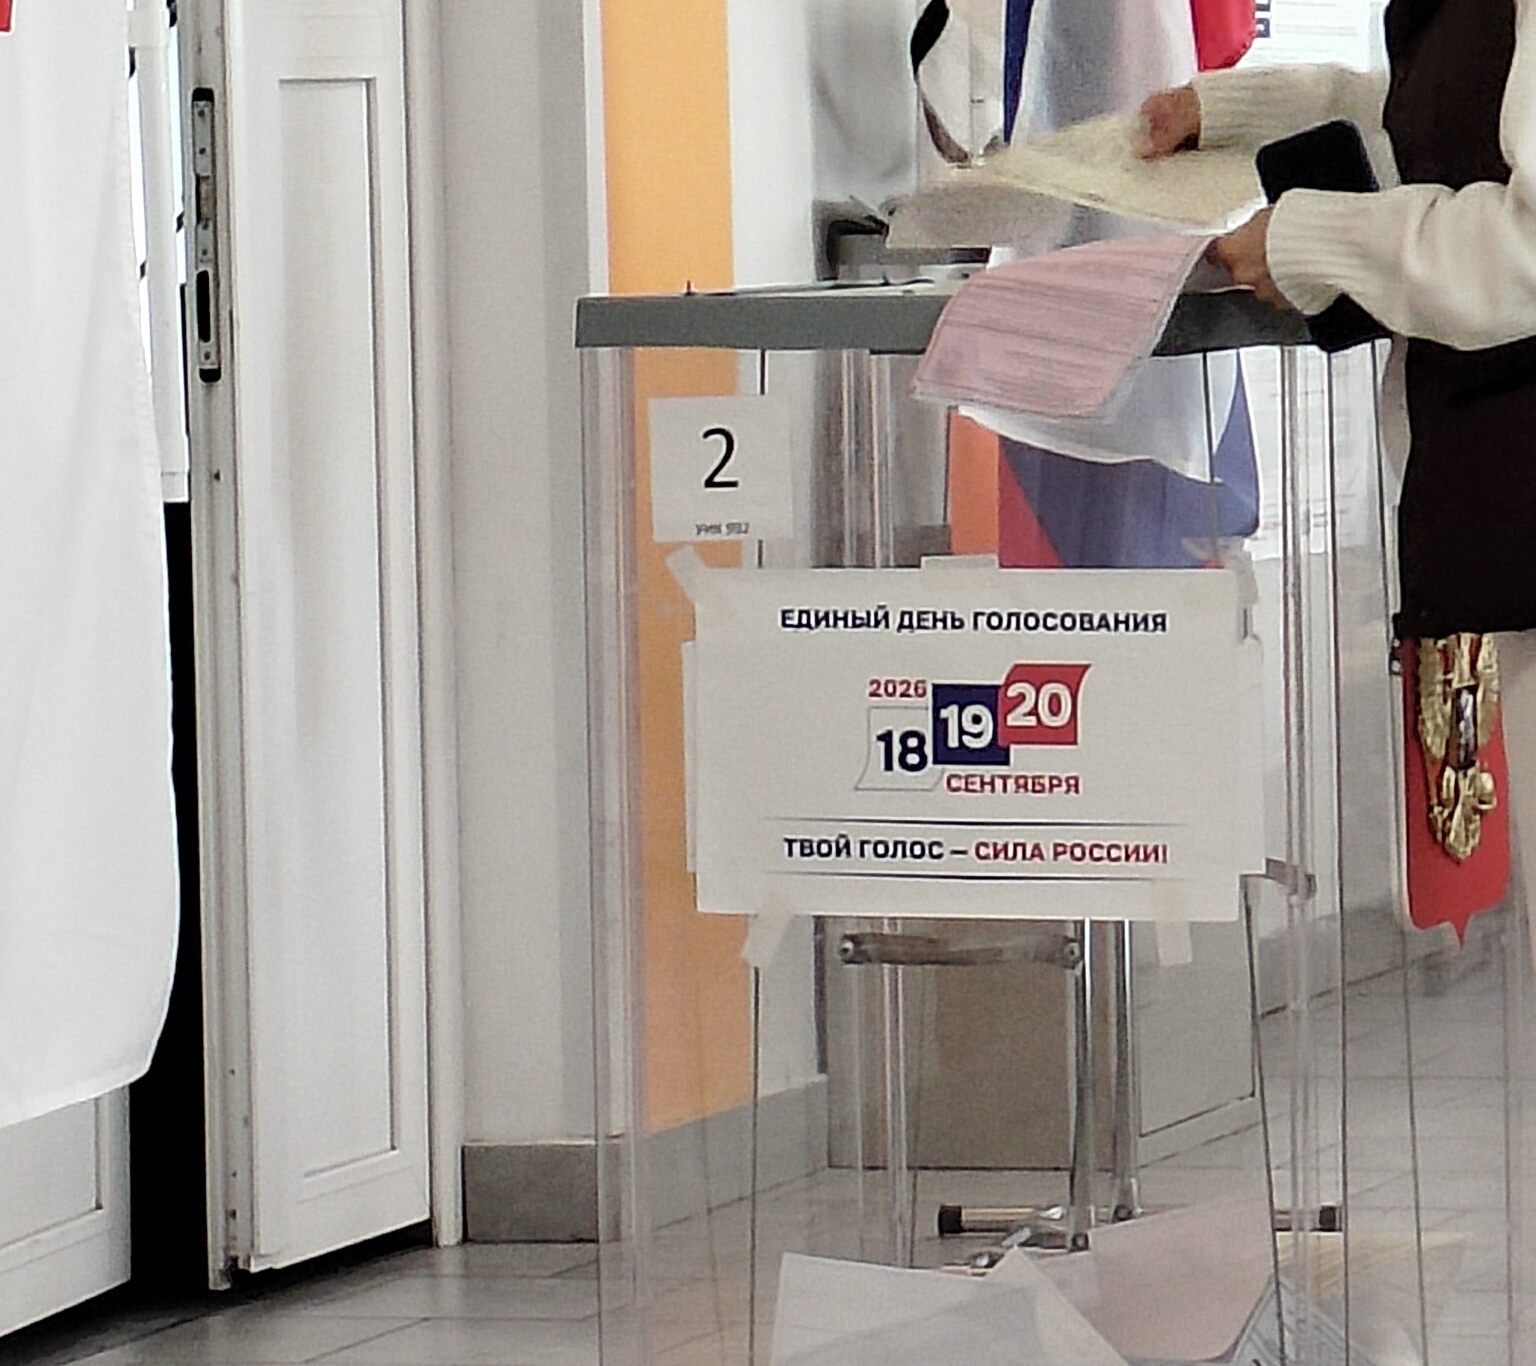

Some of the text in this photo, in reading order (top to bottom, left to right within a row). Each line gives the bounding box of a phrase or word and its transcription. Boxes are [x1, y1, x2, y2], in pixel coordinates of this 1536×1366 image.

[702, 427, 739, 488] 2
[780, 604, 1168, 633] ЕДИНЫЙ ДЕНЬ ГОЛОСОВАНИЯ
[867, 678, 928, 699] 2026
[875, 682, 1073, 773] 18 19 20
[946, 773, 1081, 795] СЕНТЯБРЯ
[783, 833, 851, 860] ТВОЙ
[859, 838, 945, 861] ГОЛОС
[975, 841, 1045, 863] СИЛА
[1052, 842, 1169, 865] РОССИИ!
